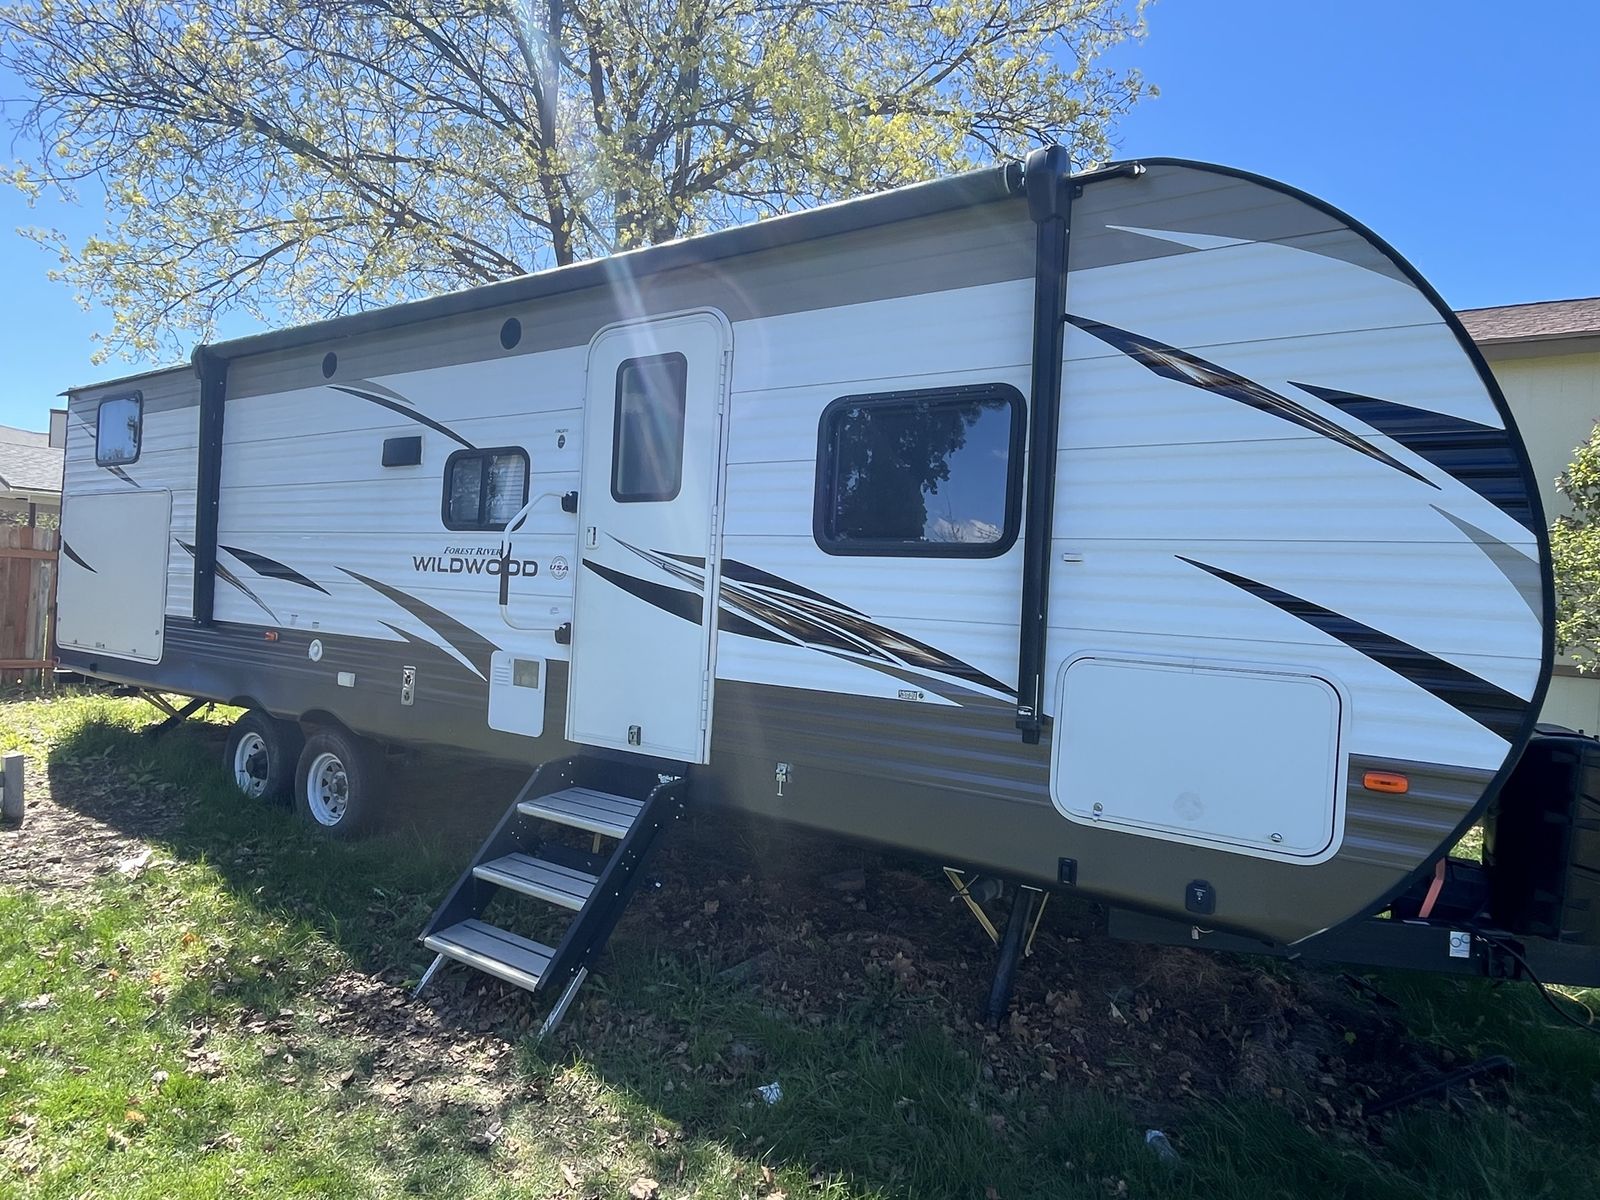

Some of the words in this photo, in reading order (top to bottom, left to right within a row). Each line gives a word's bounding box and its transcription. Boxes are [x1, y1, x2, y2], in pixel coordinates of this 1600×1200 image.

[444, 546, 475, 555] FOREST
[476, 547, 501, 556] RIVER
[412, 556, 538, 577] WILDWOOD
